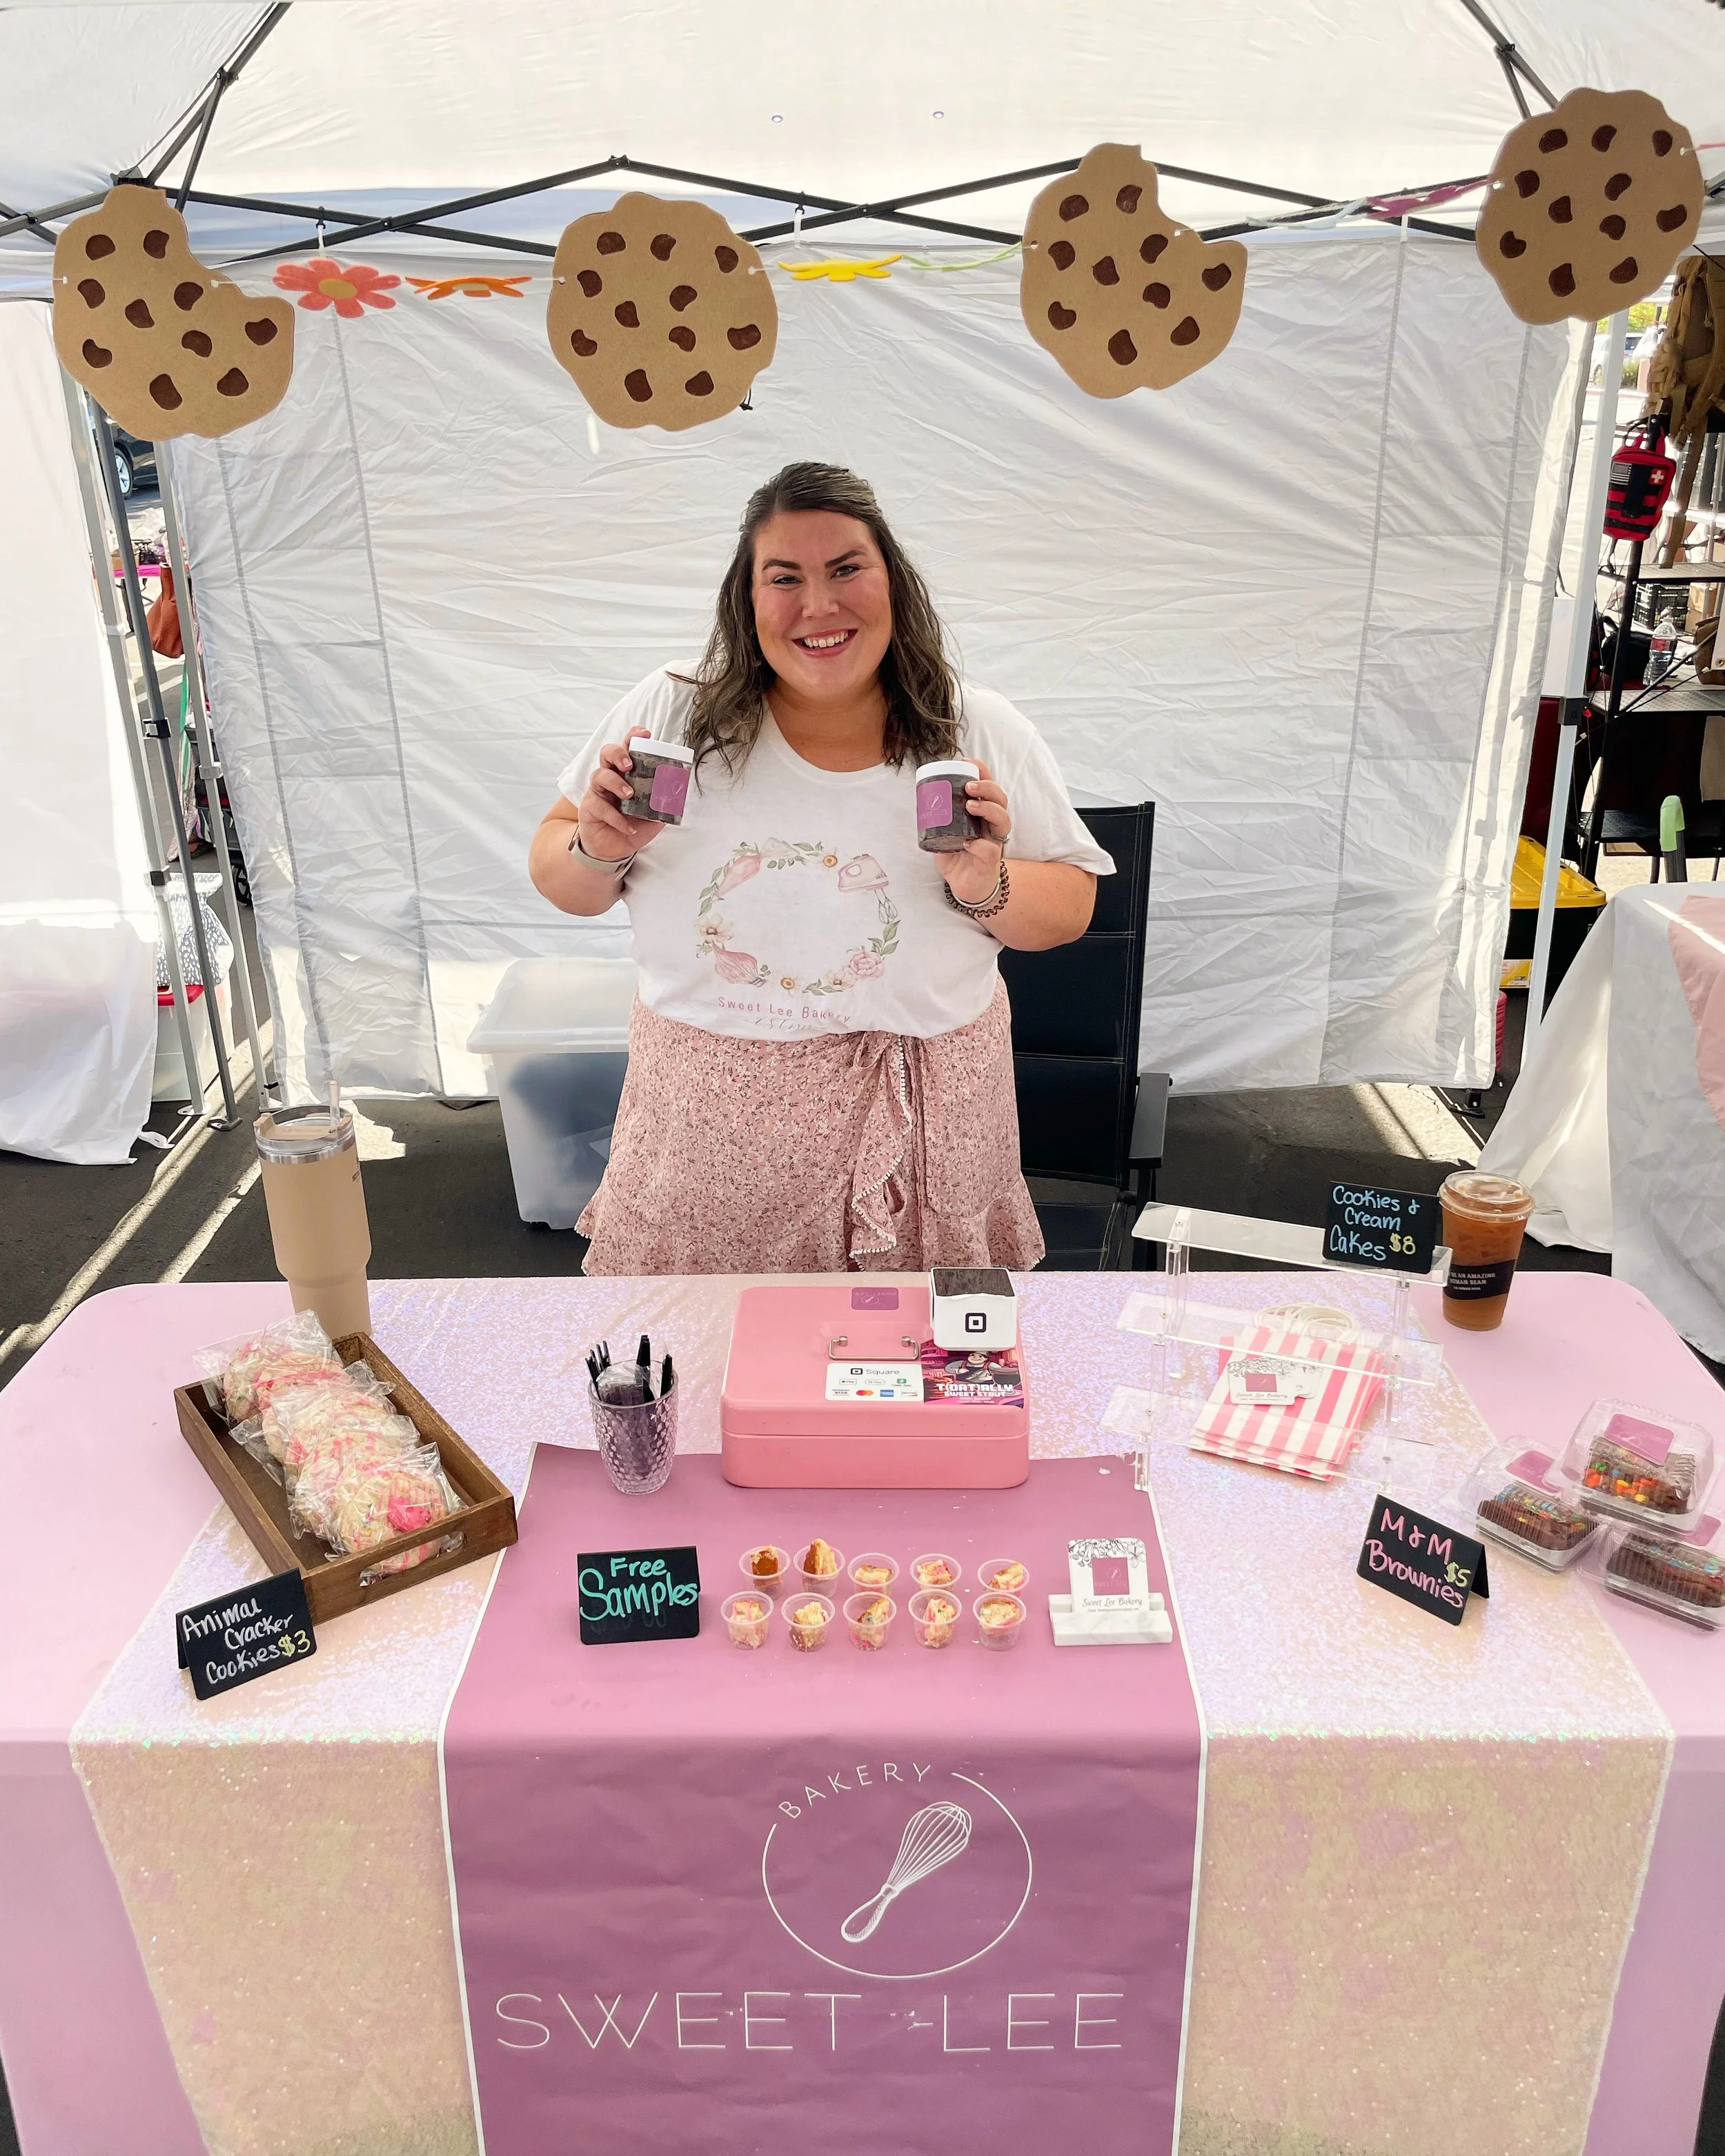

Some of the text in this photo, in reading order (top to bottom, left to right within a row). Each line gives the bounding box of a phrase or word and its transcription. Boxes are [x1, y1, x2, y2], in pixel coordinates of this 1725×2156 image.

[718, 996, 851, 1023] Sweet Lee Bakery
[1332, 1185, 1401, 1212] Cookies
[1345, 1207, 1401, 1231] Cream
[1330, 1225, 1416, 1261] Cakes $8
[1381, 1507, 1405, 1541] M
[1427, 1533, 1452, 1565] M
[610, 1557, 667, 1578] Free
[1366, 1539, 1471, 1608] Brownies $5
[578, 1567, 698, 1621] Samples
[1082, 1596, 1143, 1608] Sweet Lee Bakery
[182, 1597, 263, 1642] Animal
[224, 1614, 294, 1650] Cracker
[206, 1630, 310, 1685] Cookies $3
[778, 1762, 931, 1819] BAKERY
[495, 1991, 1125, 2053] SWEET LEE
